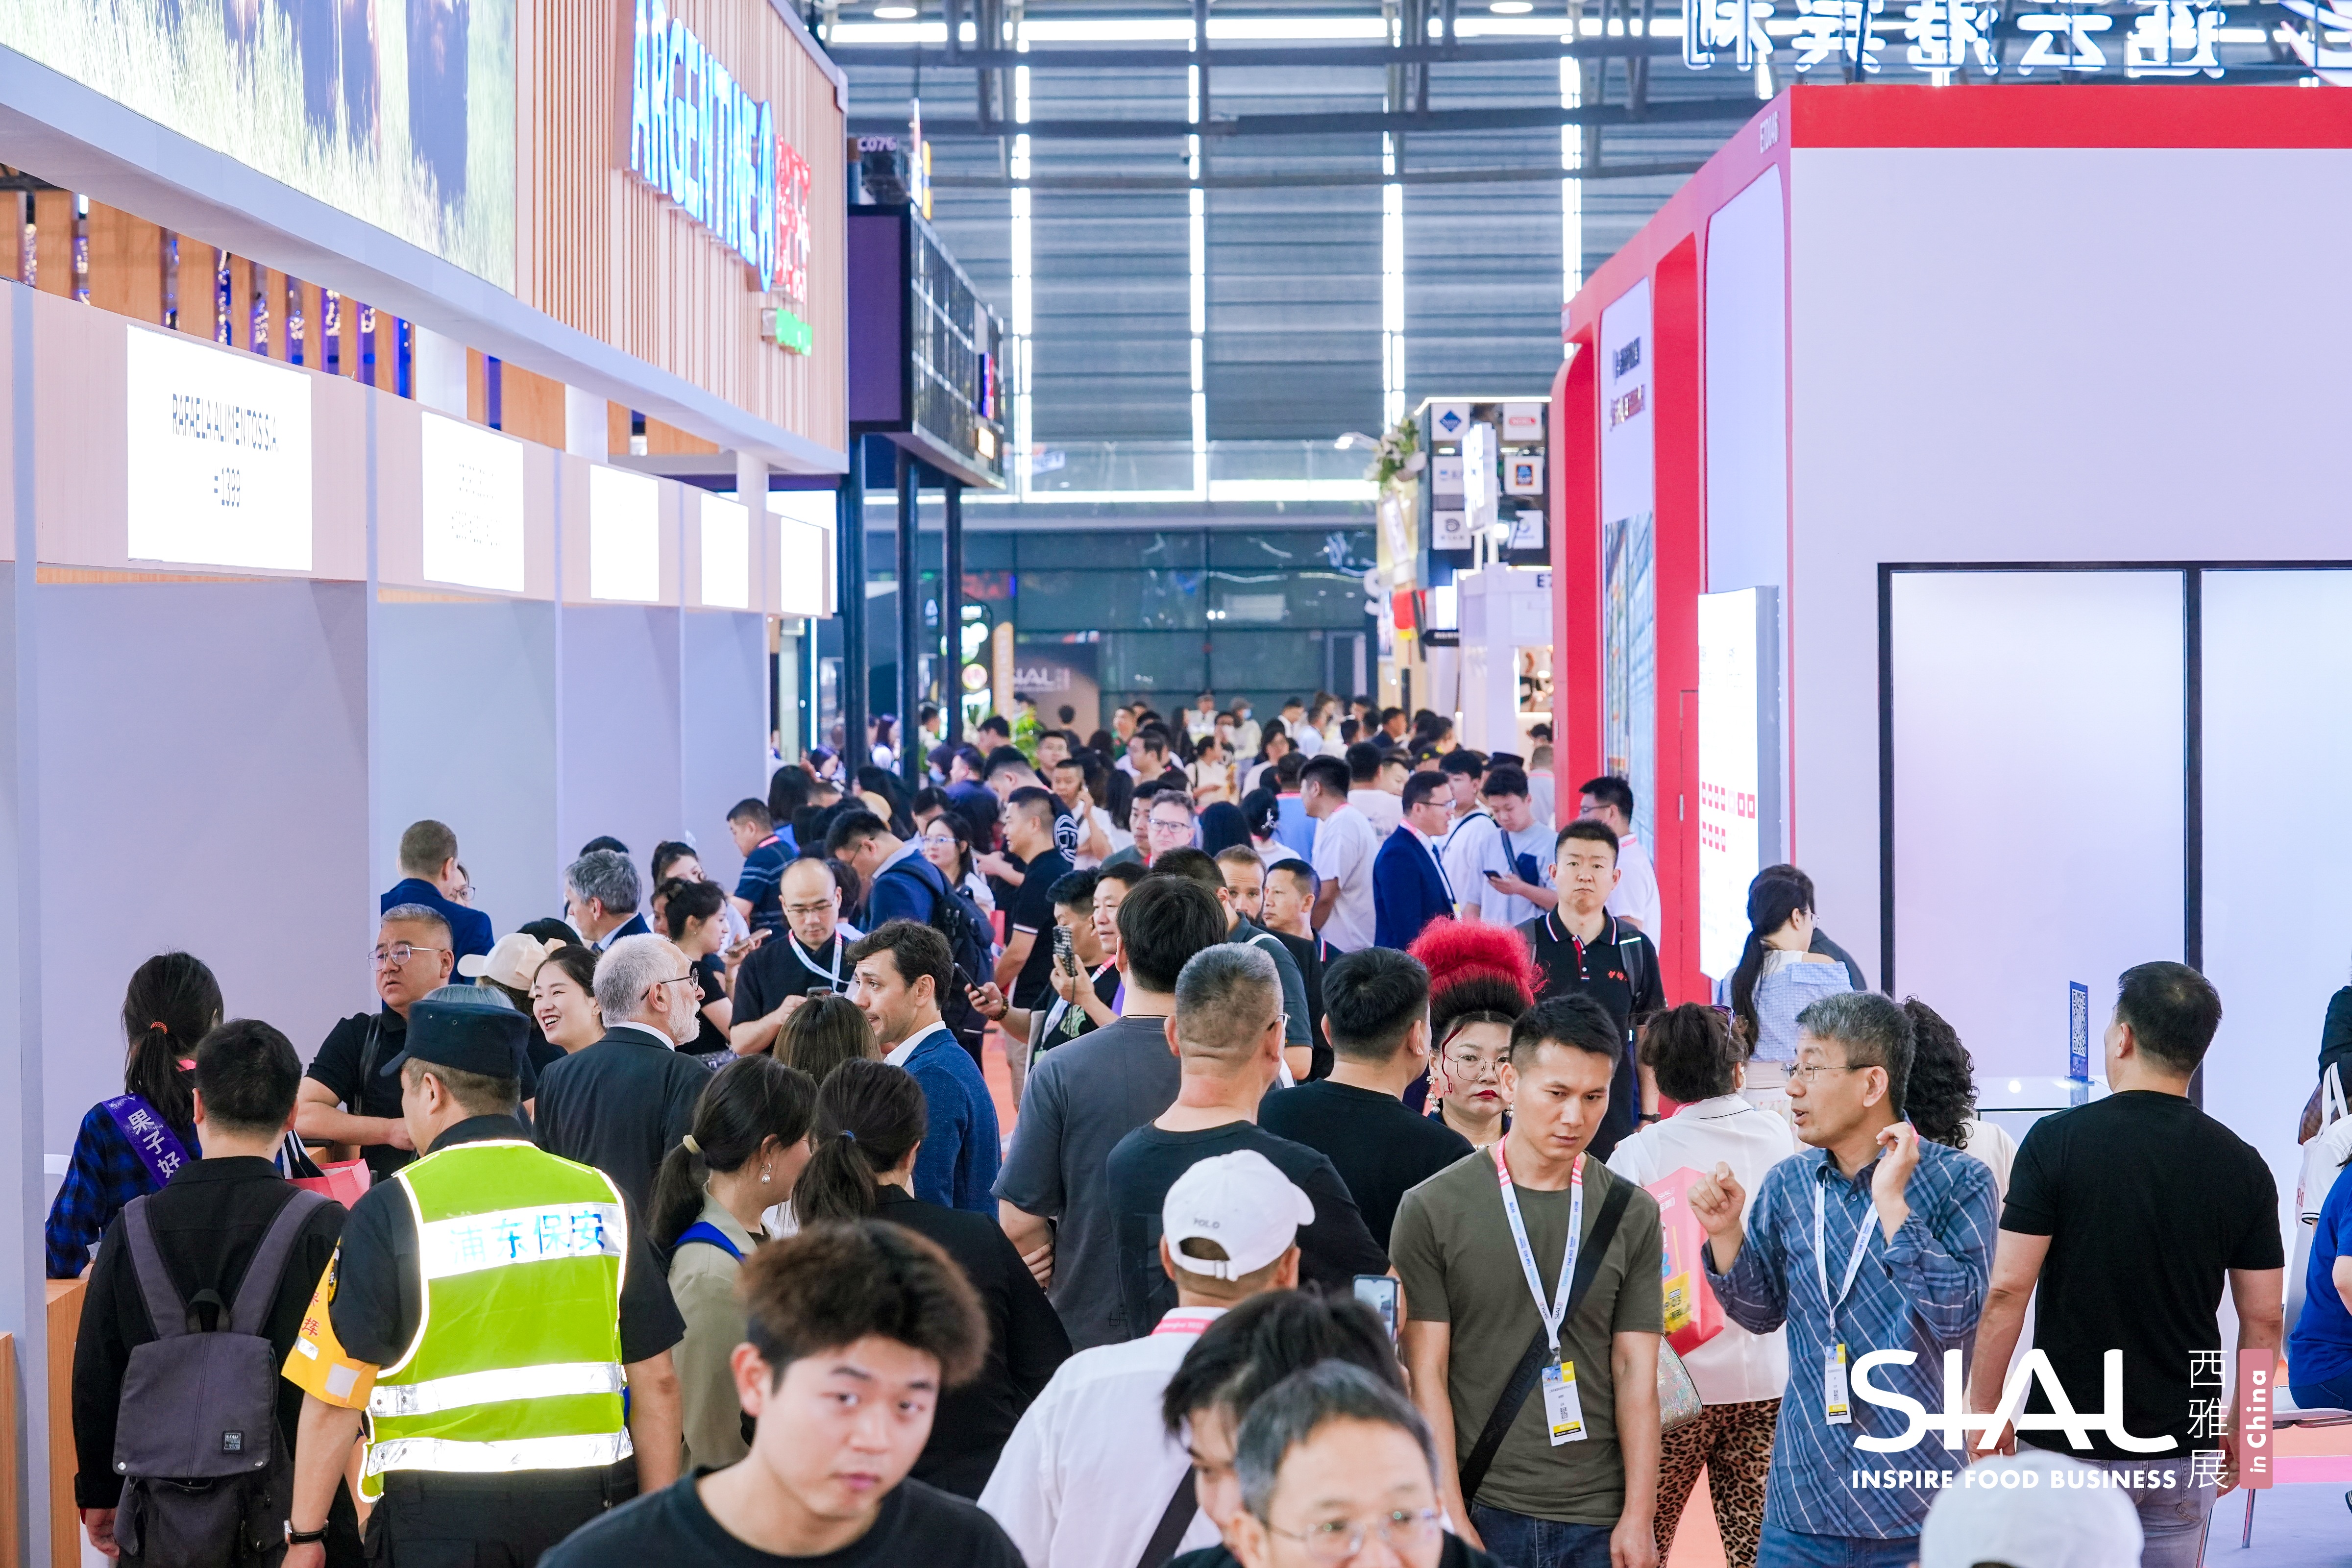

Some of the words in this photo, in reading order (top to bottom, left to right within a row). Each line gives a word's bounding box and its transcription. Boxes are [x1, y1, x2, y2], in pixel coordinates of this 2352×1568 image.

[172, 393, 212, 440] RAFAELA
[214, 402, 262, 450] ALIMENTOS
[265, 413, 279, 453] S.A.
[1014, 667, 1055, 685] IAL
[127, 1108, 180, 1178] 果子好
[450, 1210, 605, 1264] 浦东保安
[1194, 1218, 1220, 1229] POLO
